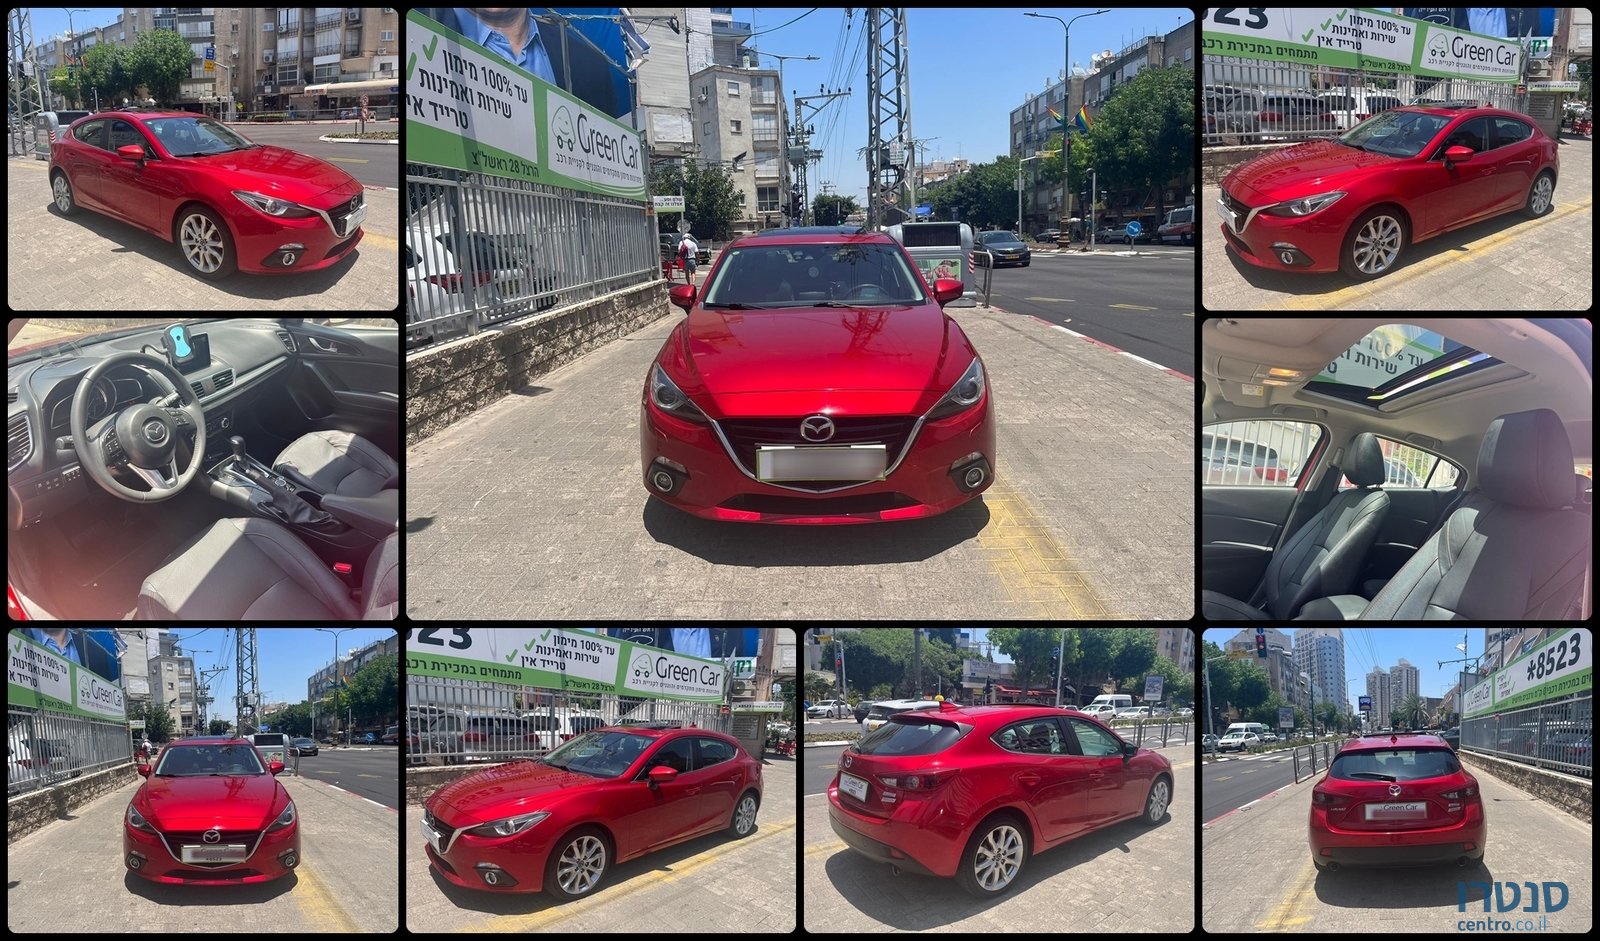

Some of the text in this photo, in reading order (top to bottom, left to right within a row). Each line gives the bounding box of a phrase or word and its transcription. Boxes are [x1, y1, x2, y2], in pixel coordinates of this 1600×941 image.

[1349, 14, 1411, 35] עד 100% מימון
[1332, 24, 1396, 44] שירות ואמינות
[1227, 40, 1272, 54] במכירת
[1317, 35, 1362, 50] טרייד אין
[1276, 46, 1318, 60] מתמחים
[1451, 36, 1516, 67] Green Car
[1388, 61, 1396, 70] 28
[442, 50, 528, 103] עד 100% מימון
[418, 67, 512, 119] שירות ואמינות
[428, 100, 468, 129] טרייד
[577, 113, 638, 170] Green Car
[509, 158, 520, 174] 28
[556, 152, 566, 164] רכב
[520, 160, 539, 178] הרצל
[1354, 351, 1398, 374] שירות
[1408, 353, 1423, 367] עד
[553, 635, 615, 655] עד 100% מימון
[24, 647, 42, 663] מימון
[535, 645, 600, 664] שירות ואמינות
[12, 656, 59, 682] שירות ואמינות
[43, 655, 59, 671] 100%
[431, 661, 477, 675] במכירת
[521, 656, 566, 670] טרייד אין
[17, 672, 37, 687] טרייד
[480, 666, 522, 680] מתמחים
[655, 656, 720, 687] Green Car
[592, 682, 600, 690] 28
[1559, 677, 1580, 691] במכירת
[91, 679, 122, 706] Green Car
